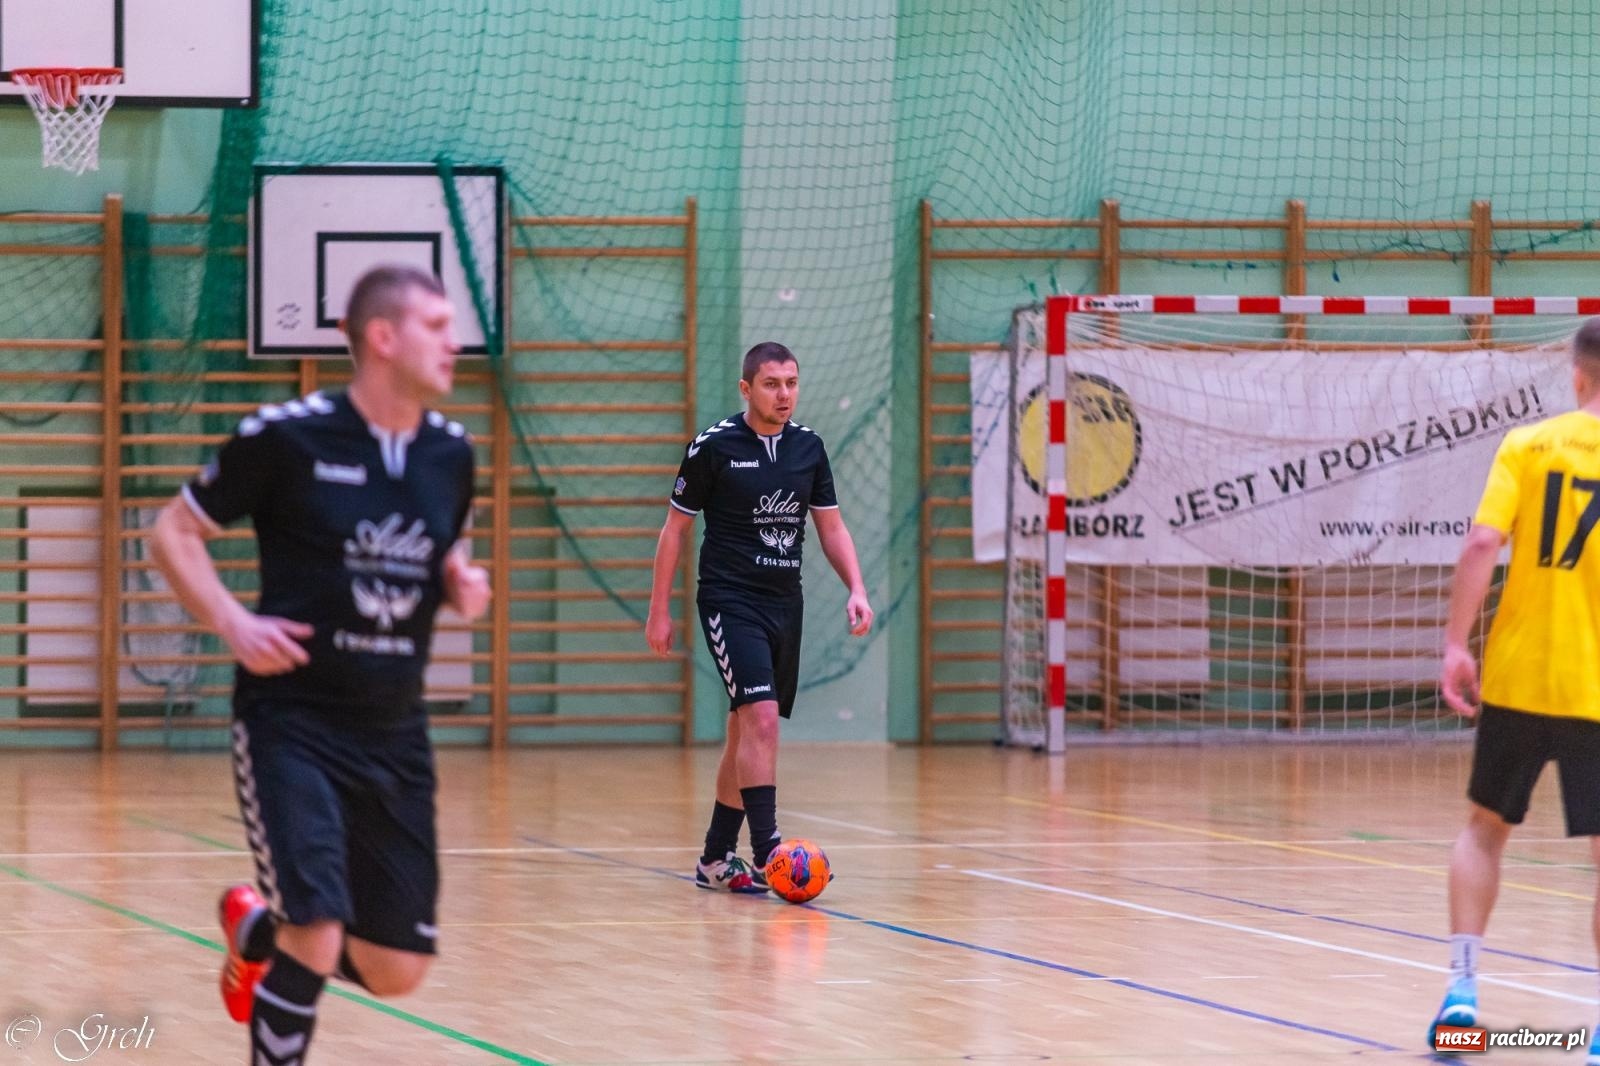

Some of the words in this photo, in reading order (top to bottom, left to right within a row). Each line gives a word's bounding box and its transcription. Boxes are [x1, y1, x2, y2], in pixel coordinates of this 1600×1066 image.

[730, 459, 760, 468] hummel
[752, 489, 801, 515] Ada
[1169, 473, 1258, 528] JEST
[1269, 459, 1306, 494] W
[753, 516, 774, 524] SALON
[1538, 470, 1600, 570] 17
[763, 557, 777, 566] 514
[778, 559, 791, 568] 260
